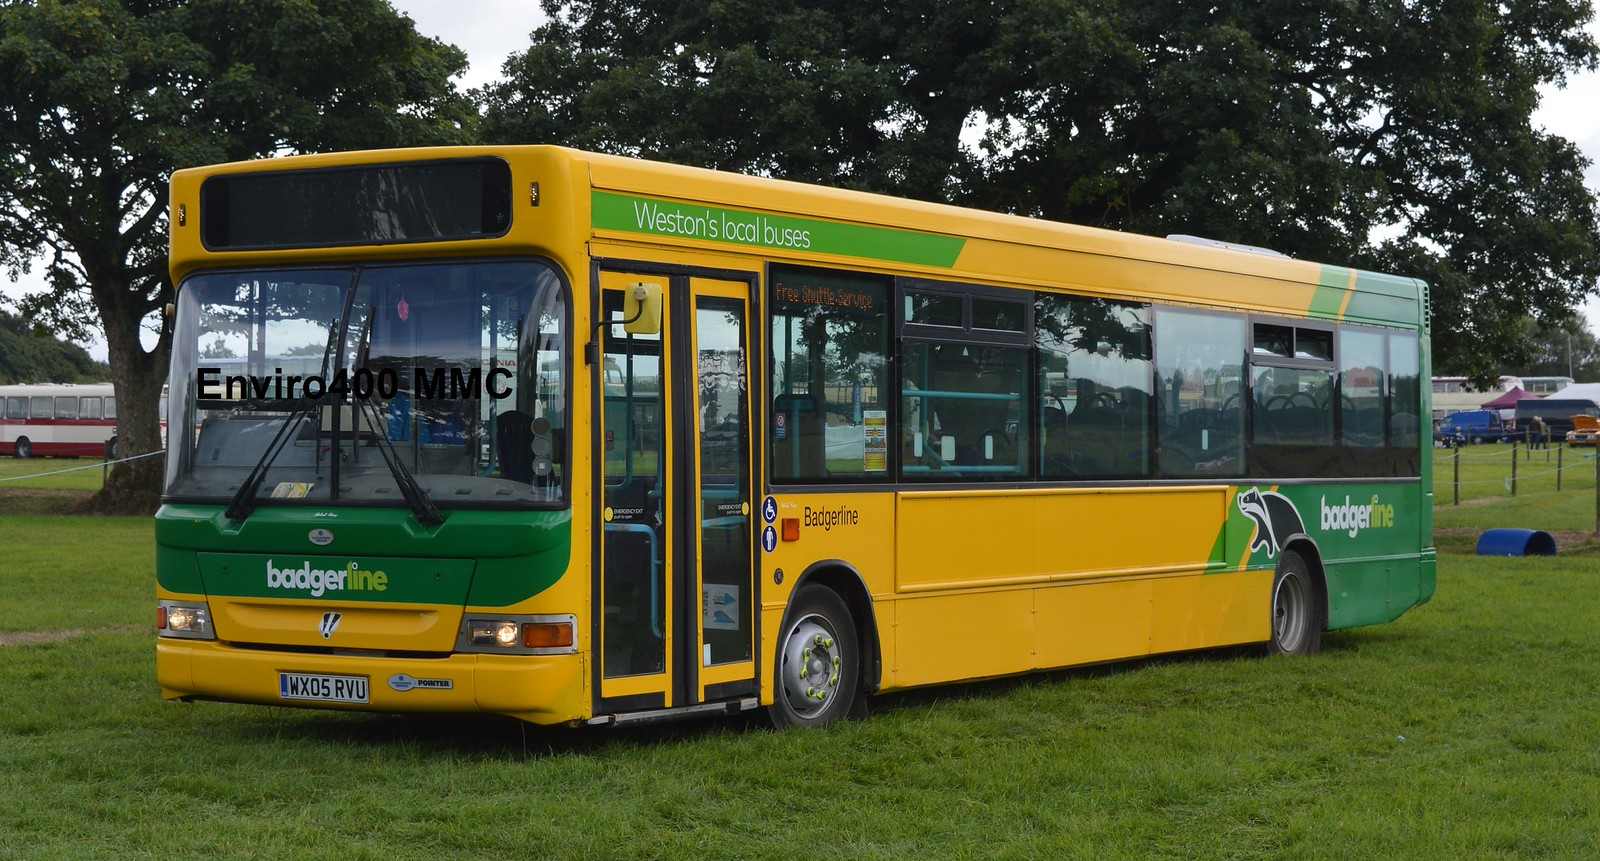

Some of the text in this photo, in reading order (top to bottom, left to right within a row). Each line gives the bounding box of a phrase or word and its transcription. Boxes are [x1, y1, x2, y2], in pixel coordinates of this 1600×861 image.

[633, 201, 811, 249] Weston's local buses
[776, 282, 873, 309] Free Shuttle Service
[804, 504, 859, 532] Badgerline
[1320, 494, 1394, 538] badgerline
[266, 558, 388, 597] badgerline
[289, 676, 366, 700] WX05 RVU
[417, 679, 450, 687] POINTER
